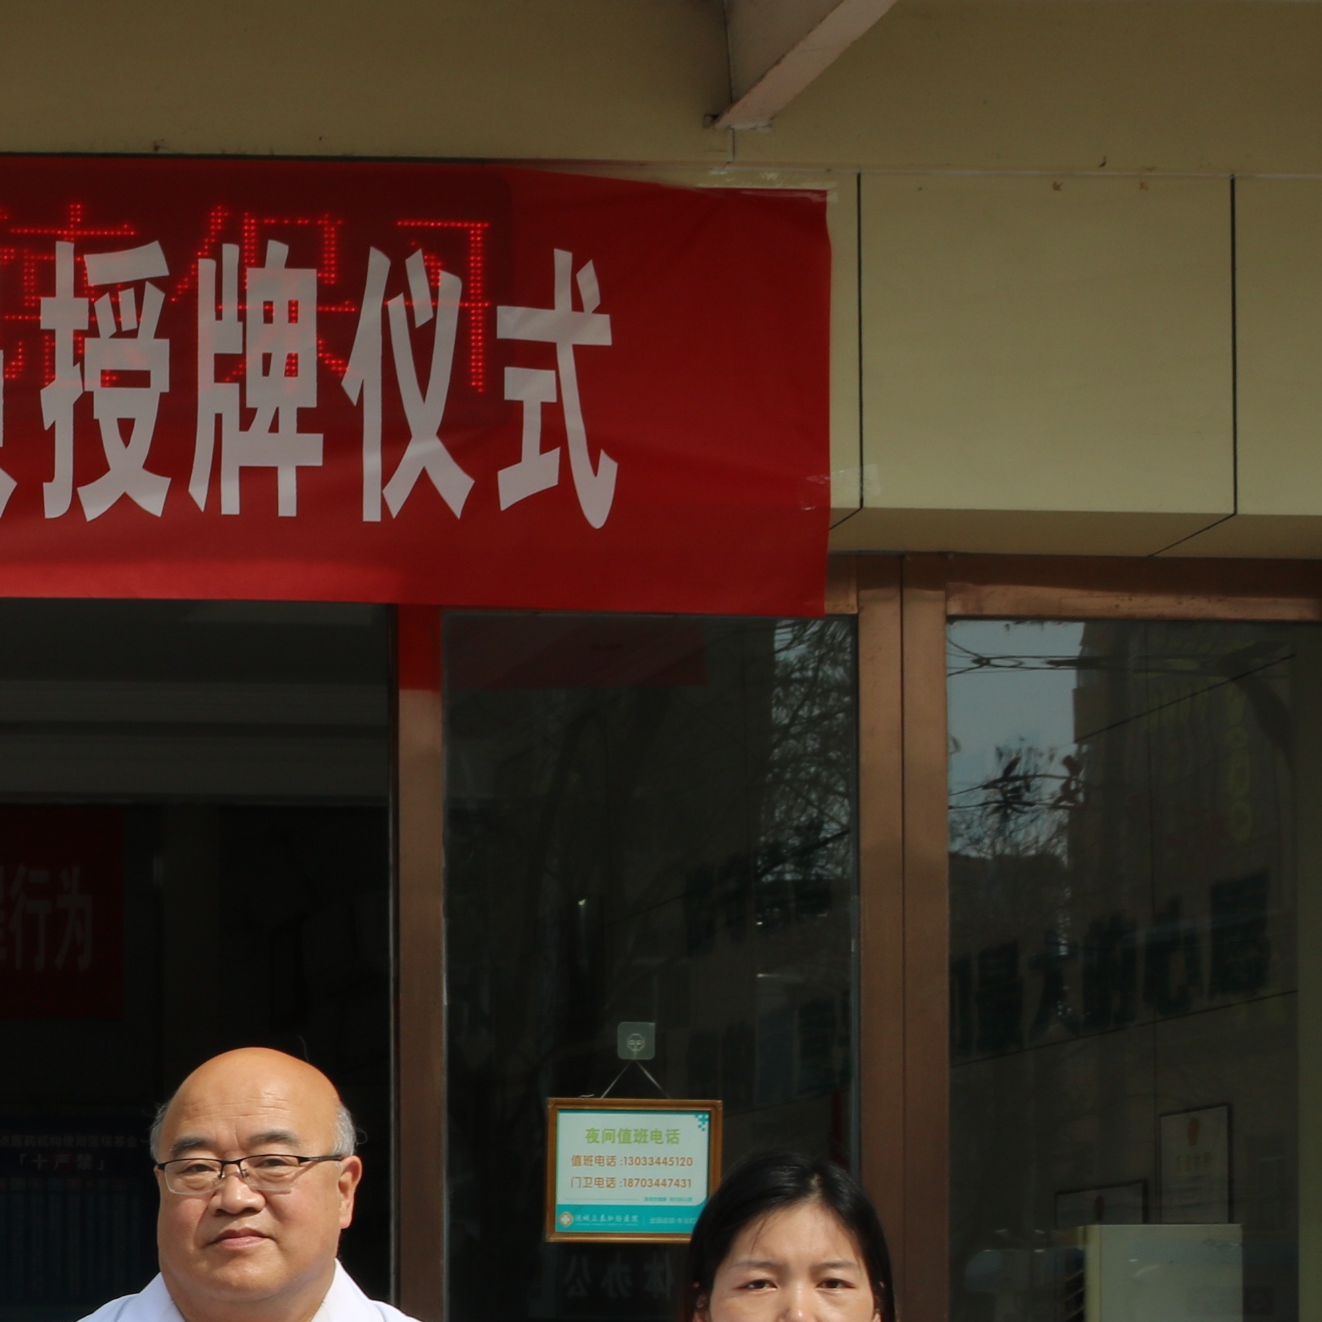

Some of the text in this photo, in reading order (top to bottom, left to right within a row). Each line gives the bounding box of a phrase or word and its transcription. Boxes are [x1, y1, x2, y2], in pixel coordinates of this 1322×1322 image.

[584, 1127, 681, 1146] 夜间值班电话
